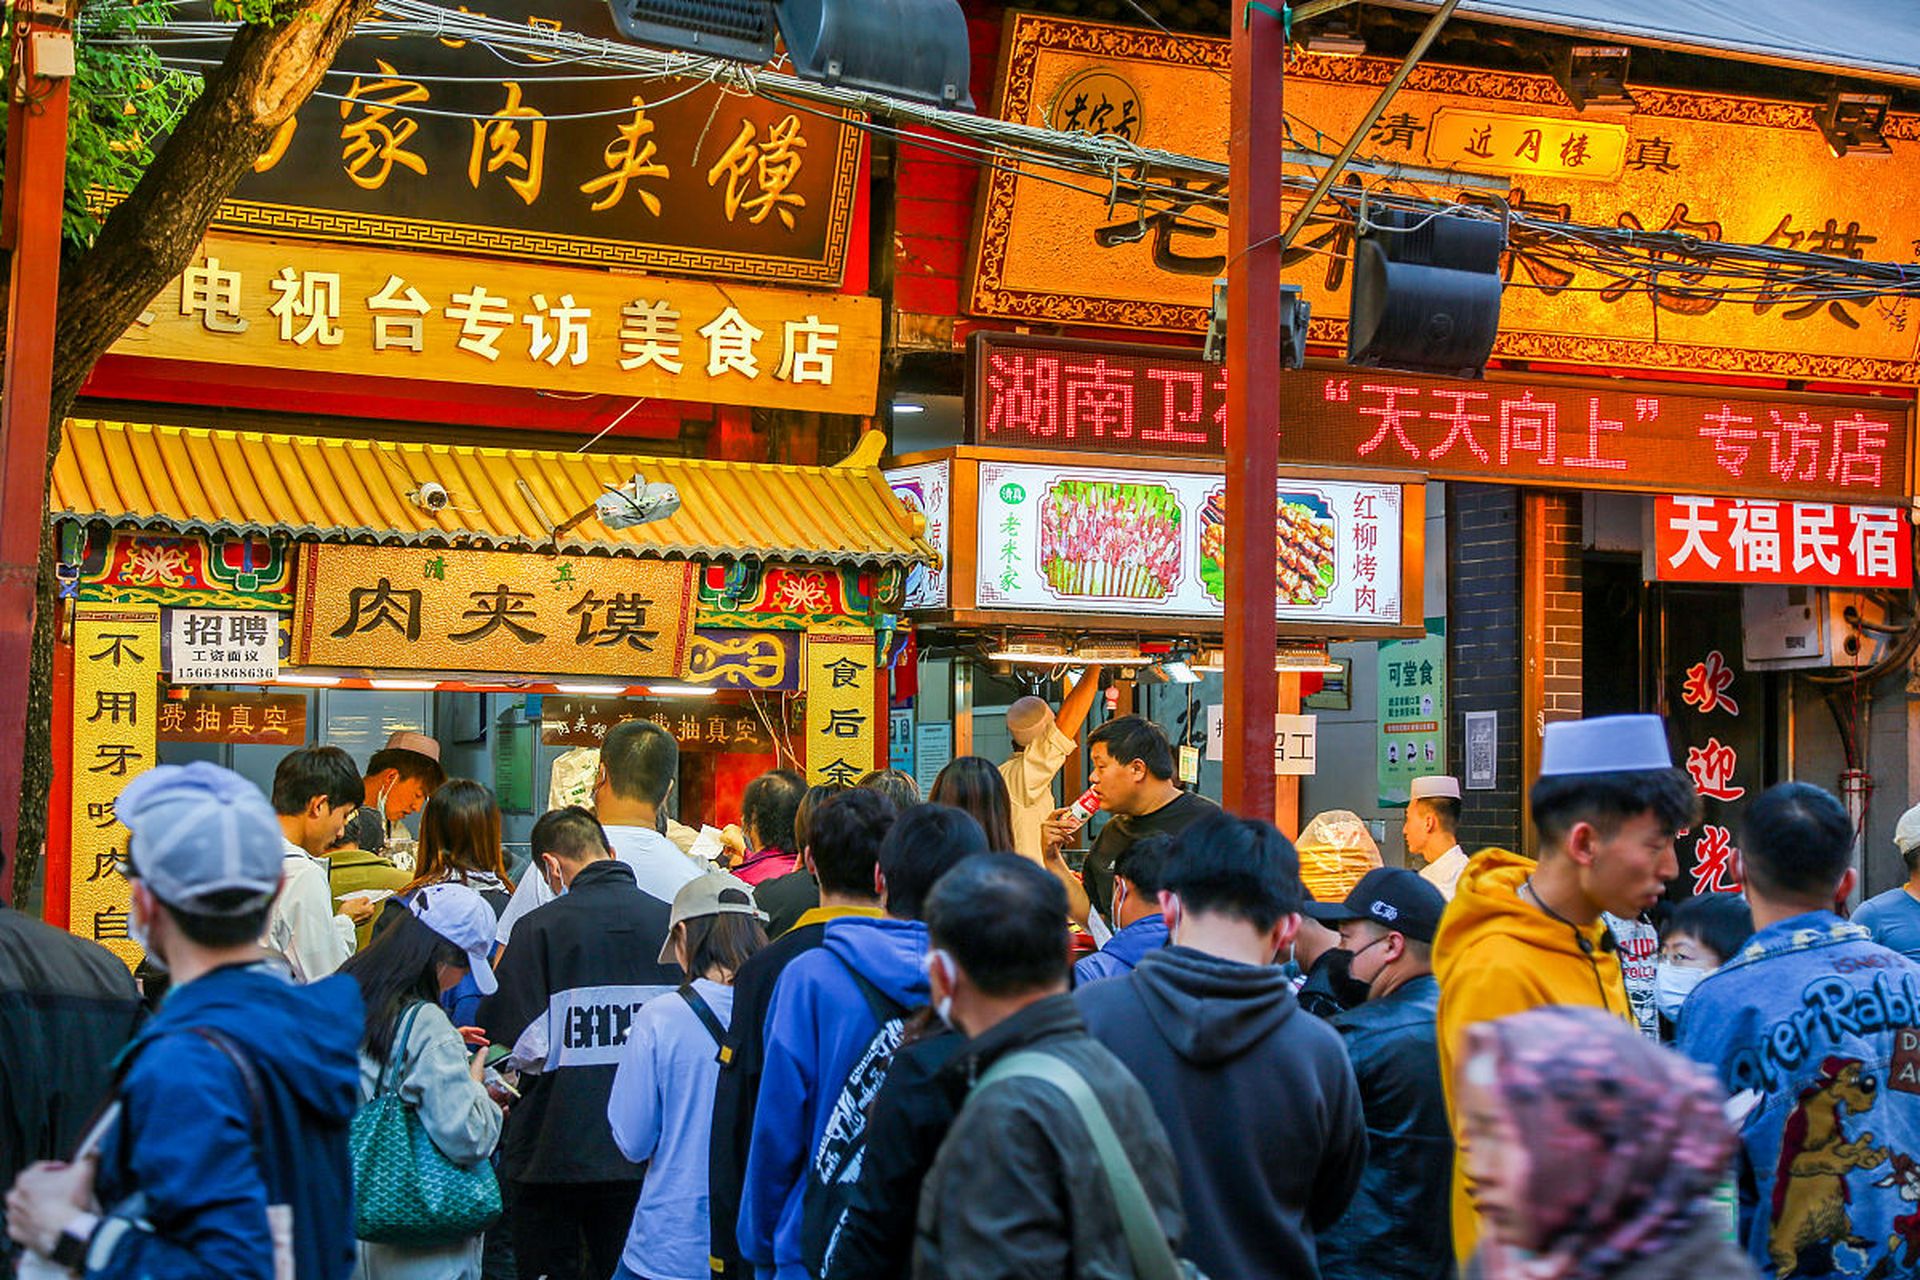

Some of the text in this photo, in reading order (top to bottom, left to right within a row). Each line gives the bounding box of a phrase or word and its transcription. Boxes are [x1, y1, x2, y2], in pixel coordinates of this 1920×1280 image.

[255, 57, 807, 231] 家肉夹馍
[1370, 113, 1425, 151] 清
[1625, 136, 1681, 174] 真
[136, 256, 840, 387] 电视台专访美食店
[986, 354, 1229, 448] 湖南卫
[1698, 404, 1892, 488] 专访店
[999, 511, 1023, 593] 老米家
[1352, 491, 1378, 614] 红柳烤肉
[1667, 494, 1899, 580] 天福民宿
[184, 613, 269, 647] 招聘
[330, 578, 660, 652] 肉夹馍
[178, 667, 274, 679] 15664868636
[192, 649, 259, 662] 工资面议
[1387, 659, 1434, 688] 可堂食
[818, 656, 868, 787] 食后余
